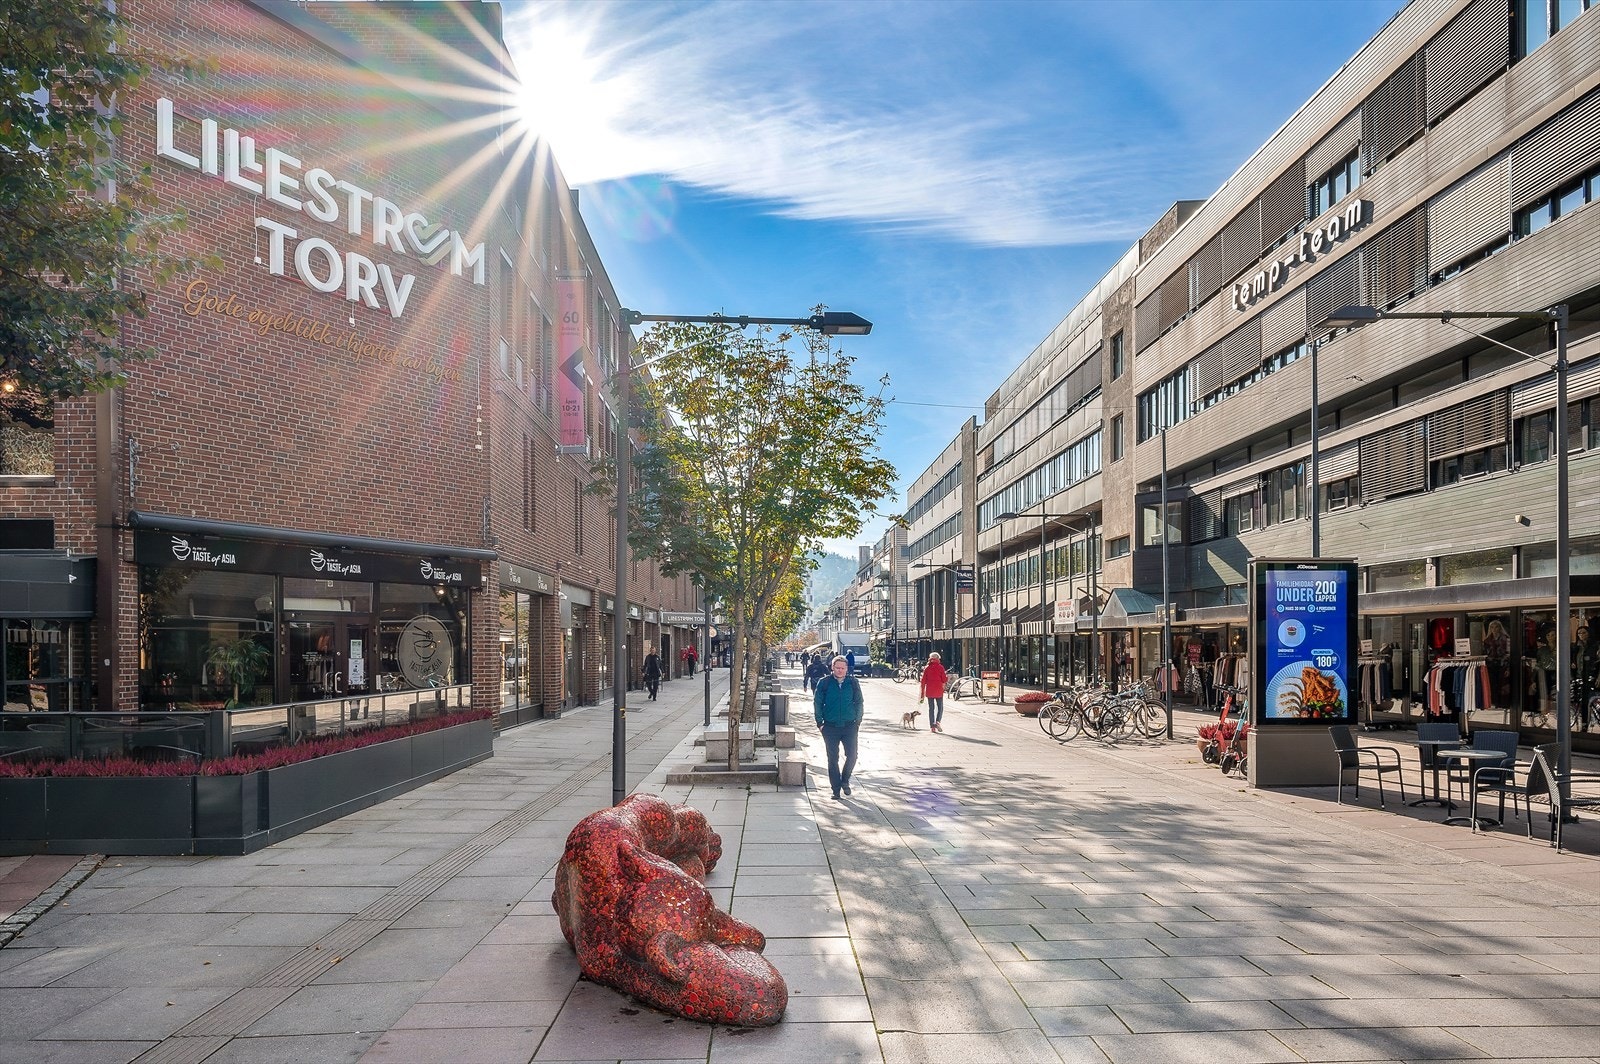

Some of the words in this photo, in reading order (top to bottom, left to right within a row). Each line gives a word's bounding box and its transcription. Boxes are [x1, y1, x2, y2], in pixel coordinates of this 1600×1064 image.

[157, 97, 485, 285] LILLESTRØM
[1232, 199, 1371, 311] temp-team
[256, 217, 415, 318] TORV
[562, 311, 580, 324] 60
[184, 279, 243, 319] Gode
[248, 306, 332, 345] øyeblikk
[336, 331, 346, 348] i
[347, 332, 400, 367] hjertet
[403, 355, 421, 369] av
[425, 354, 461, 384] byen
[192, 551, 211, 562] TASTE
[211, 554, 221, 566] of
[221, 553, 236, 564] ASIA
[326, 562, 342, 572] TASTE
[341, 565, 350, 575] of
[349, 564, 361, 574] ASIA
[433, 571, 446, 580] TASTE
[445, 573, 453, 583] of
[452, 572, 462, 581] ASIA
[1315, 580, 1337, 595] 200
[1276, 588, 1314, 602] UNDER
[1315, 594, 1337, 602] LAPPEN
[1316, 656, 1332, 667] 180
